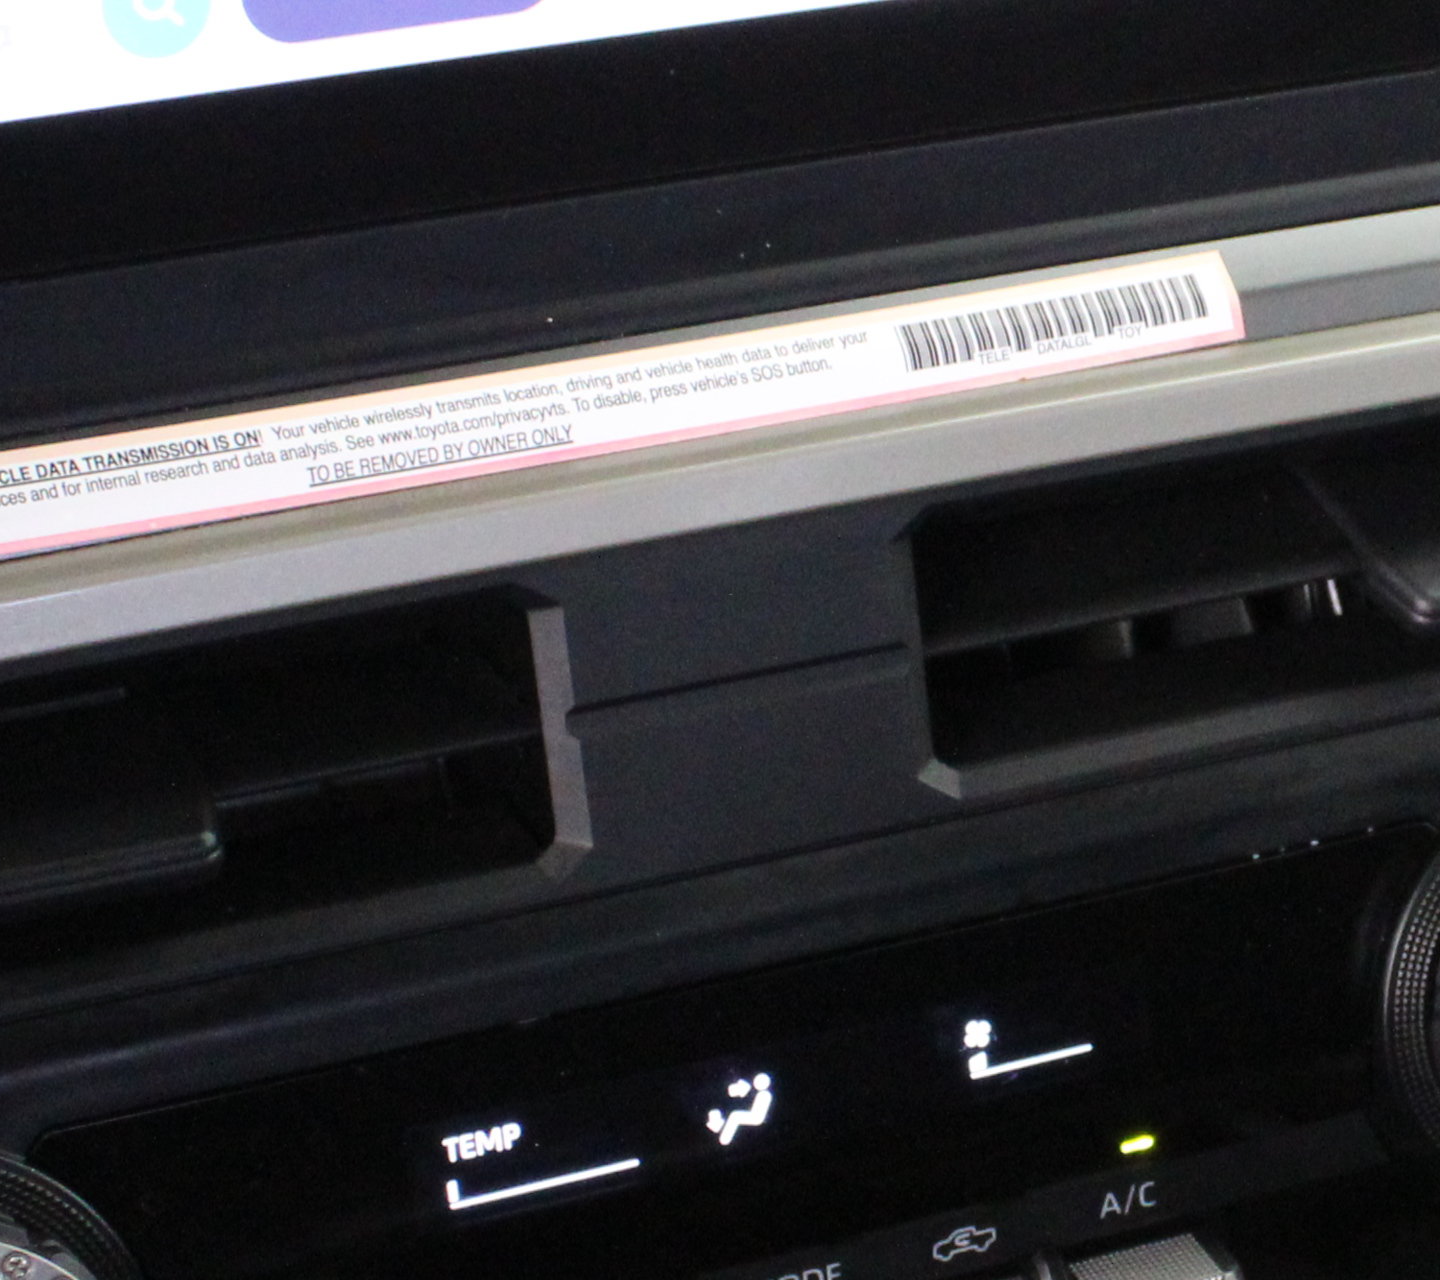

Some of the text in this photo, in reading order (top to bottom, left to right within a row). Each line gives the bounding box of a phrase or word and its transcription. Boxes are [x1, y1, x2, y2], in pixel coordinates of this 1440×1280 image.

[978, 351, 1010, 366] TELE
[1118, 326, 1144, 340] TOY
[31, 483, 58, 503] and
[61, 478, 83, 497] for
[86, 467, 141, 492] internal
[144, 458, 209, 483] research
[213, 452, 240, 472] and
[244, 448, 276, 468] data
[280, 436, 342, 462] analysis.
[345, 435, 375, 450] See
[573, 397, 591, 412] To
[593, 385, 647, 409] disable,
[649, 380, 688, 402] press
[690, 371, 749, 393] vehicle's
[751, 363, 784, 383] SOS
[786, 358, 833, 377] button.
[36, 458, 80, 480] DATA
[82, 437, 209, 472] TRANSMISSION
[213, 434, 230, 451] IS
[234, 429, 264, 448] ON!
[271, 424, 305, 441] Your
[309, 413, 359, 435] vehicle
[363, 402, 432, 426] wirelessly
[436, 391, 501, 414] transmits
[504, 383, 562, 402] location,
[566, 371, 613, 393] driving
[616, 365, 642, 385] and
[645, 356, 693, 379] vehicle
[696, 349, 738, 371] health
[742, 345, 772, 364] data
[774, 343, 788, 358] to
[792, 336, 835, 356] deliver
[838, 330, 868, 349] your
[307, 424, 573, 484] TO BE REMOVED BY OWNER ONLY
[442, 1121, 522, 1164] TEMP
[1100, 1181, 1158, 1220] A/C
